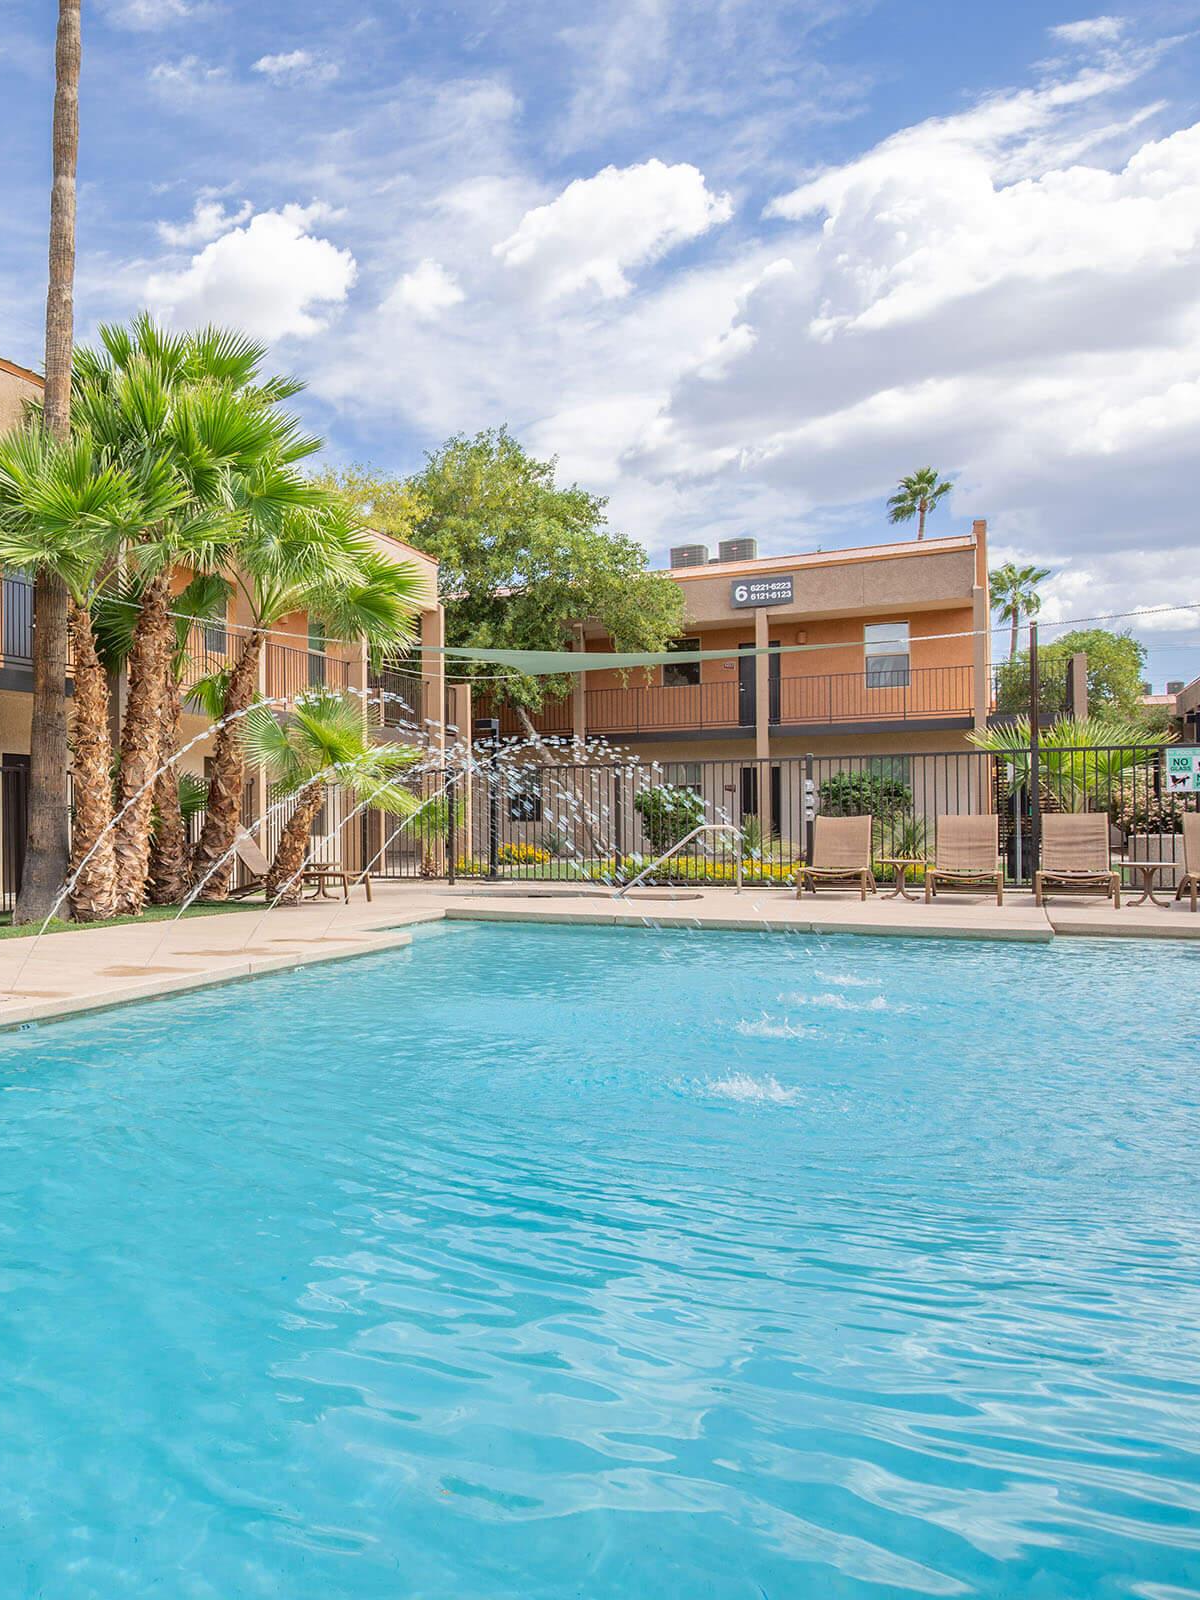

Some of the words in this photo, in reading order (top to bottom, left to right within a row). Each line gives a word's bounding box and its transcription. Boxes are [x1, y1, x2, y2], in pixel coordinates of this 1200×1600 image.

[750, 582, 791, 592] 6221-6223
[735, 585, 748, 602] 6
[750, 590, 792, 600] 6121-6123
[1173, 758, 1189, 766] NO
